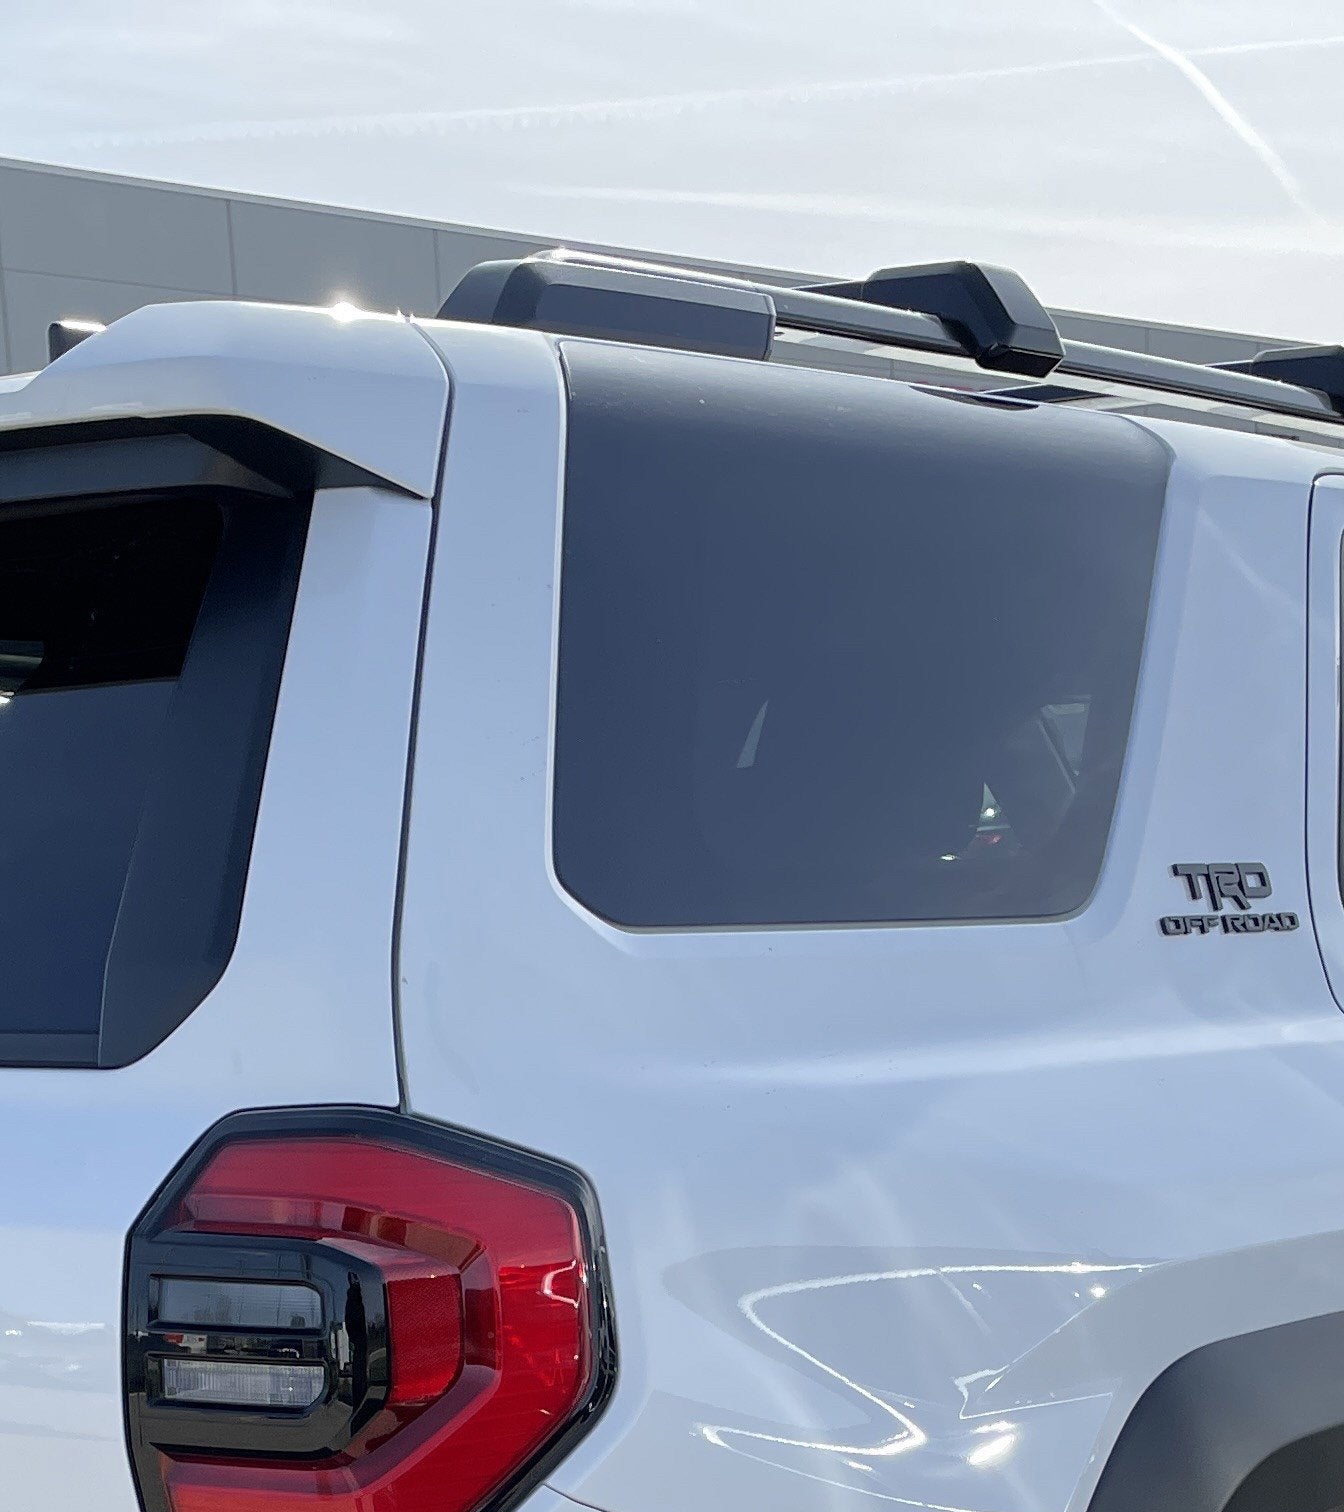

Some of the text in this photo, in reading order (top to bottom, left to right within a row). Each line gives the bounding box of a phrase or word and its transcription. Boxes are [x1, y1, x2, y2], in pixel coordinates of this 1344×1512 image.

[1170, 862, 1273, 912] TRD
[1160, 911, 1300, 937] OFF ROAD
